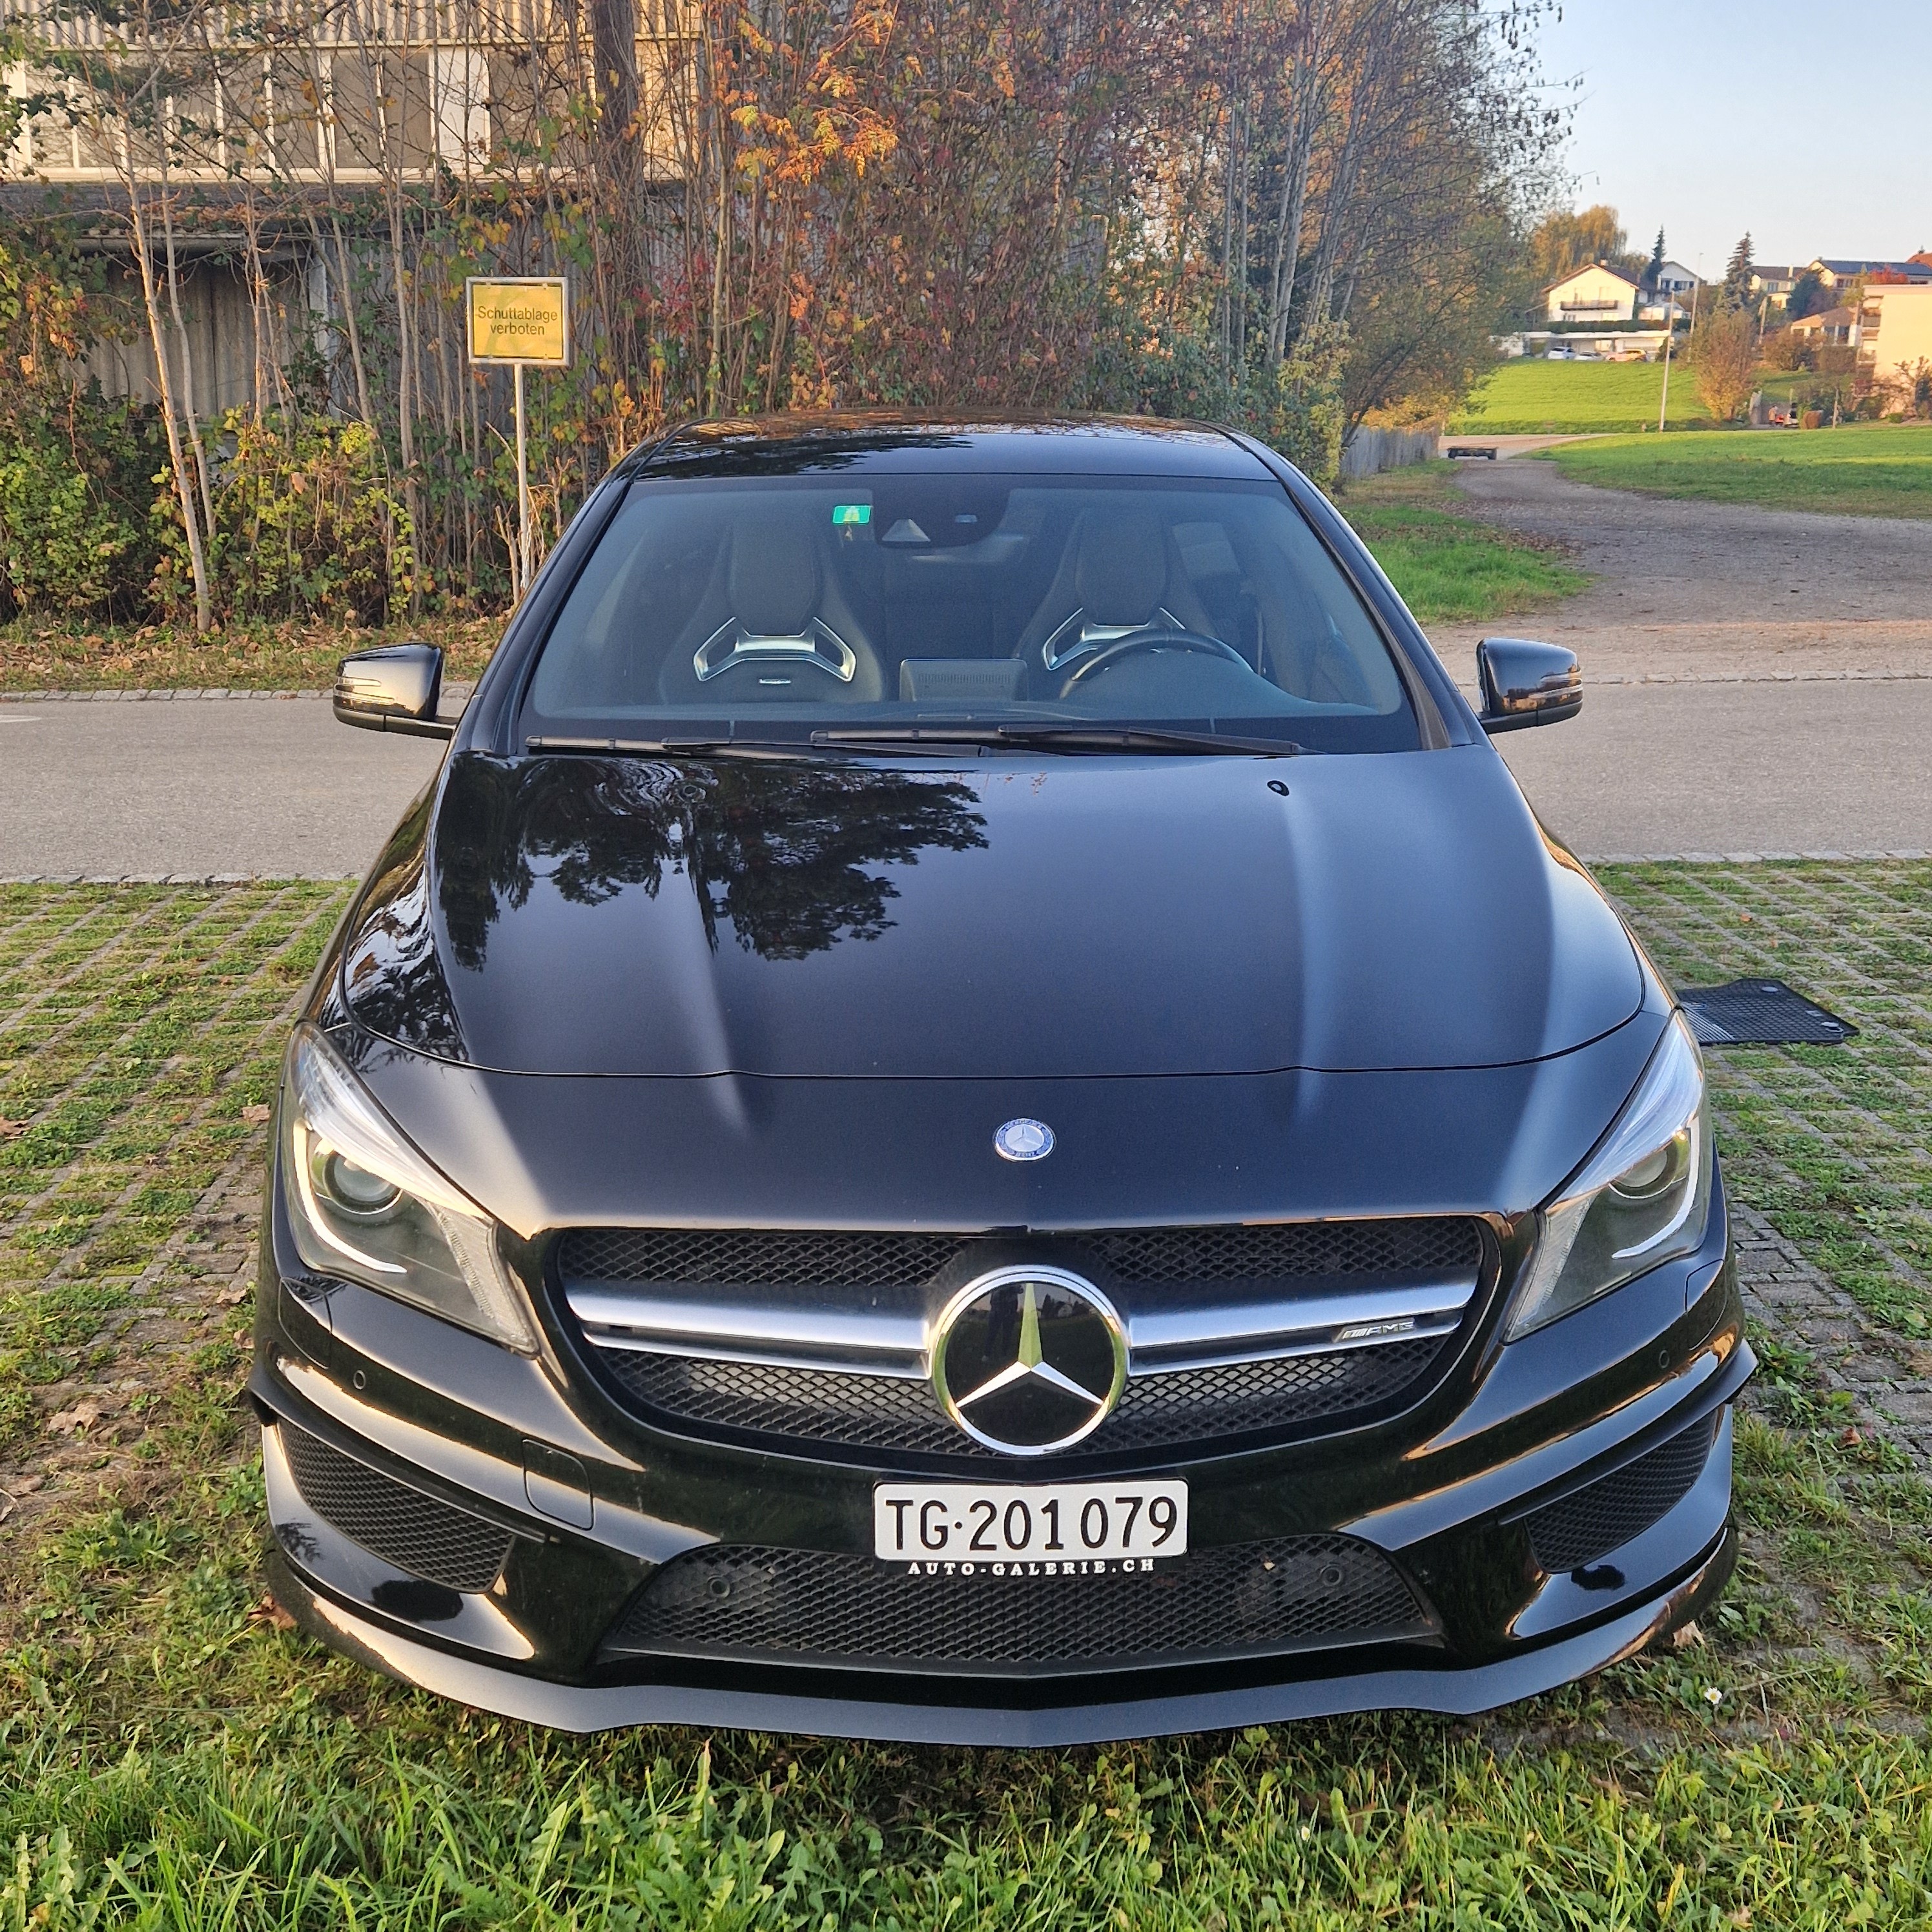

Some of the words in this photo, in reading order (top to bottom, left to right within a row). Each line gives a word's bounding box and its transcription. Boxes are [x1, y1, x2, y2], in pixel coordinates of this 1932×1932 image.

[478, 305, 558, 323] Schuttablage
[490, 322, 545, 336] verboten
[908, 1558, 1154, 1576] AUTO-GALERIE.CH
